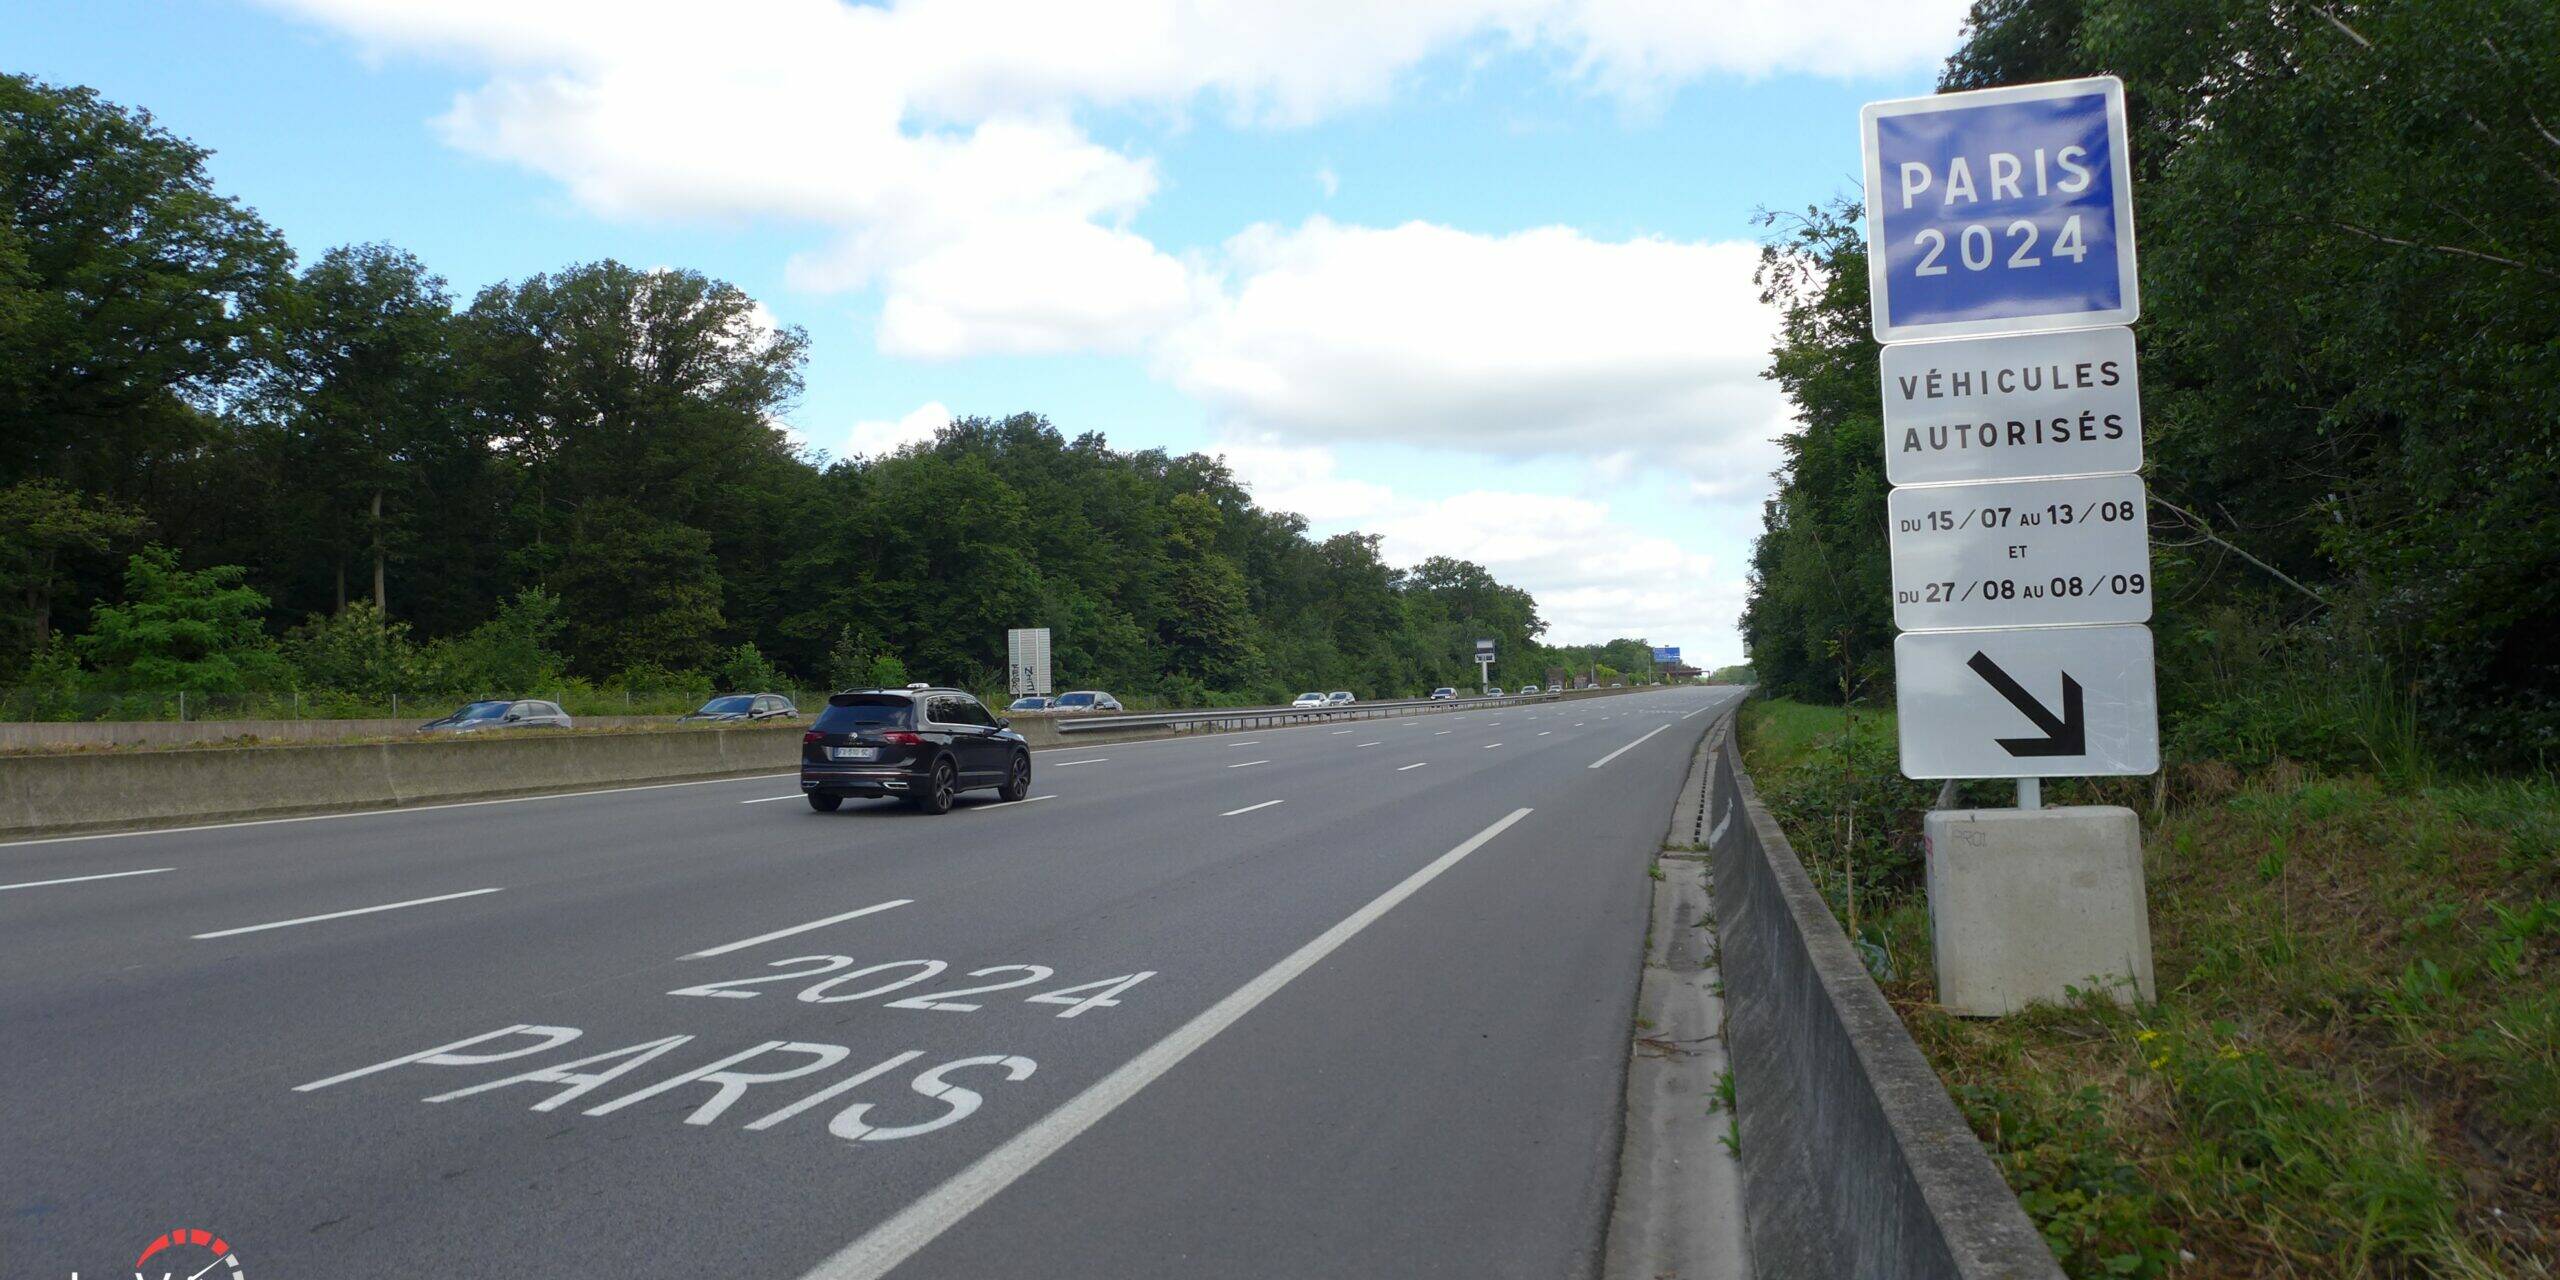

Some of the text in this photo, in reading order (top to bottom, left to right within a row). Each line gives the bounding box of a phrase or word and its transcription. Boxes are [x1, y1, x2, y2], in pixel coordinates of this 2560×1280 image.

[1900, 145, 2091, 209] PARIS
[1913, 214, 2088, 277] 2024
[1898, 361, 2120, 401] VÉHICULES
[1903, 410, 2124, 453] AUTORISÉS
[1901, 520, 1921, 532] DU
[2020, 512, 2041, 527] AU
[2009, 545, 2028, 559] ET
[1899, 590, 1919, 604] DU
[2023, 585, 2044, 599] AU
[666, 954, 1158, 1019] 2024
[290, 1023, 1038, 1141] PARIS
